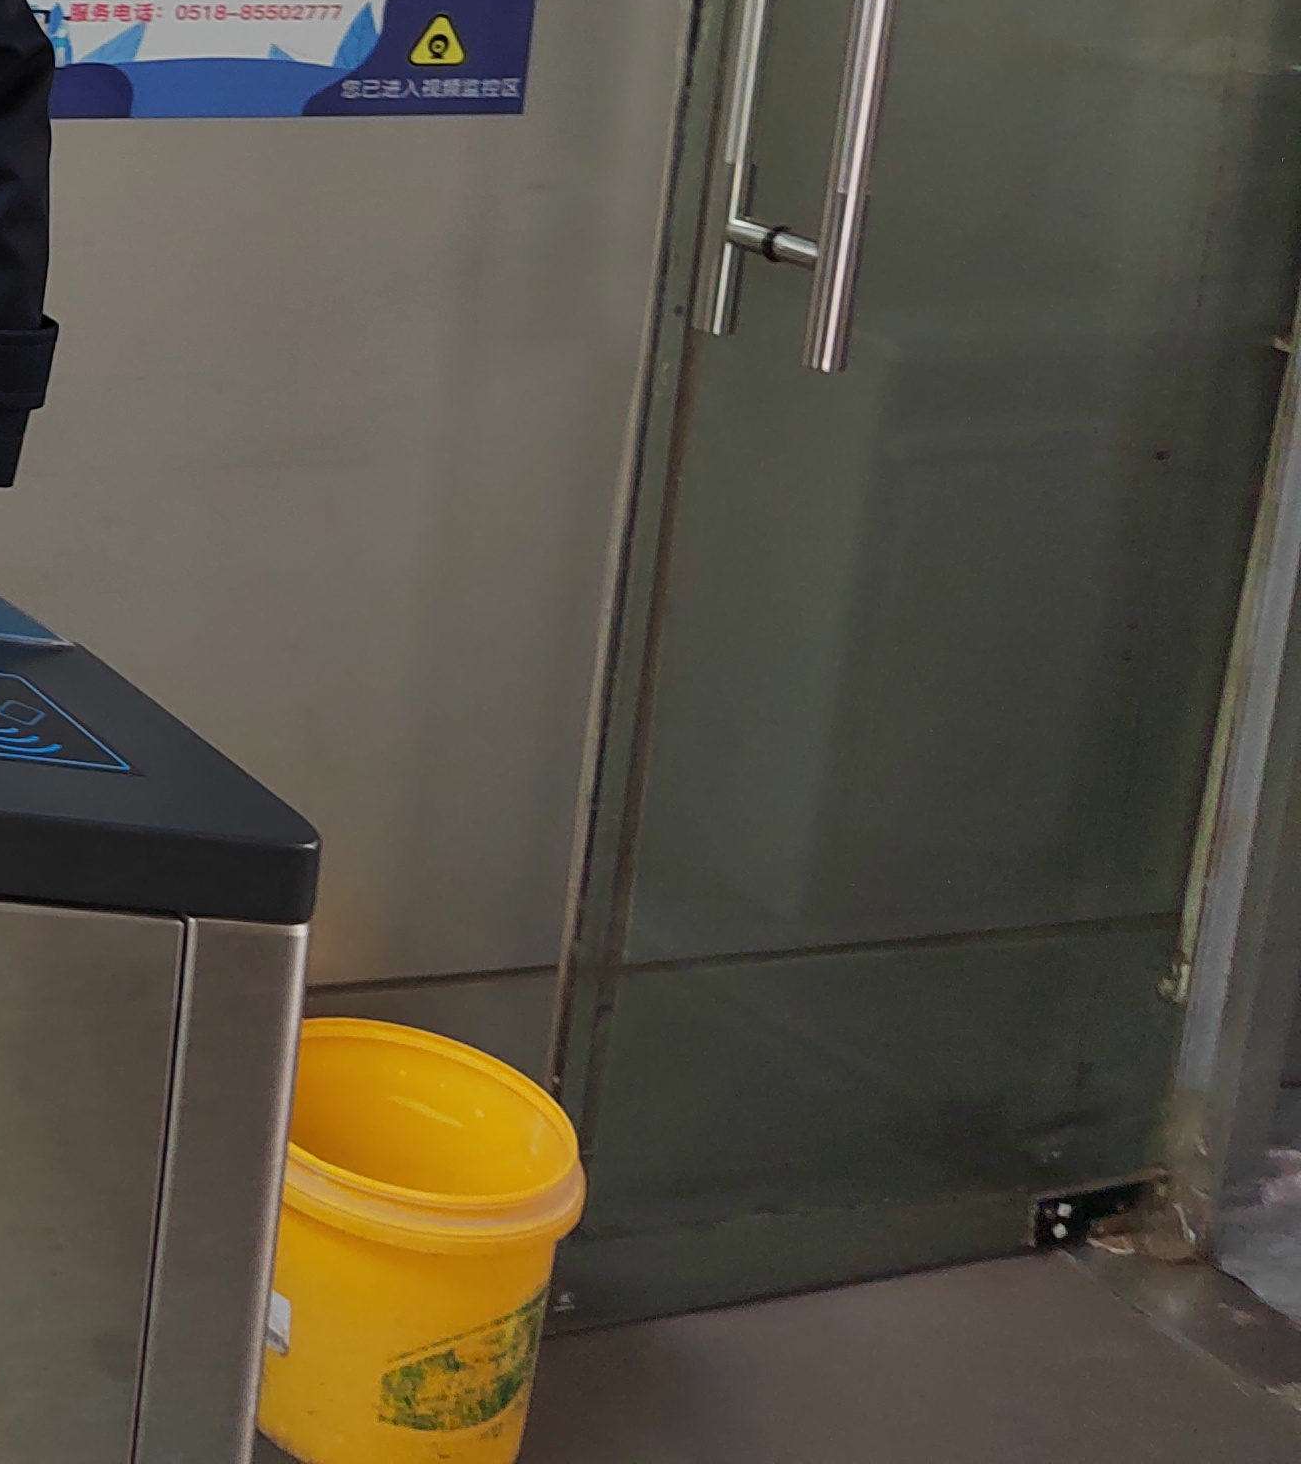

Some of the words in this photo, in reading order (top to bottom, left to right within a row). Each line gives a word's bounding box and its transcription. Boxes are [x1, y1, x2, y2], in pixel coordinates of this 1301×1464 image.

[340, 77, 521, 99] 您已进入视频监控区
